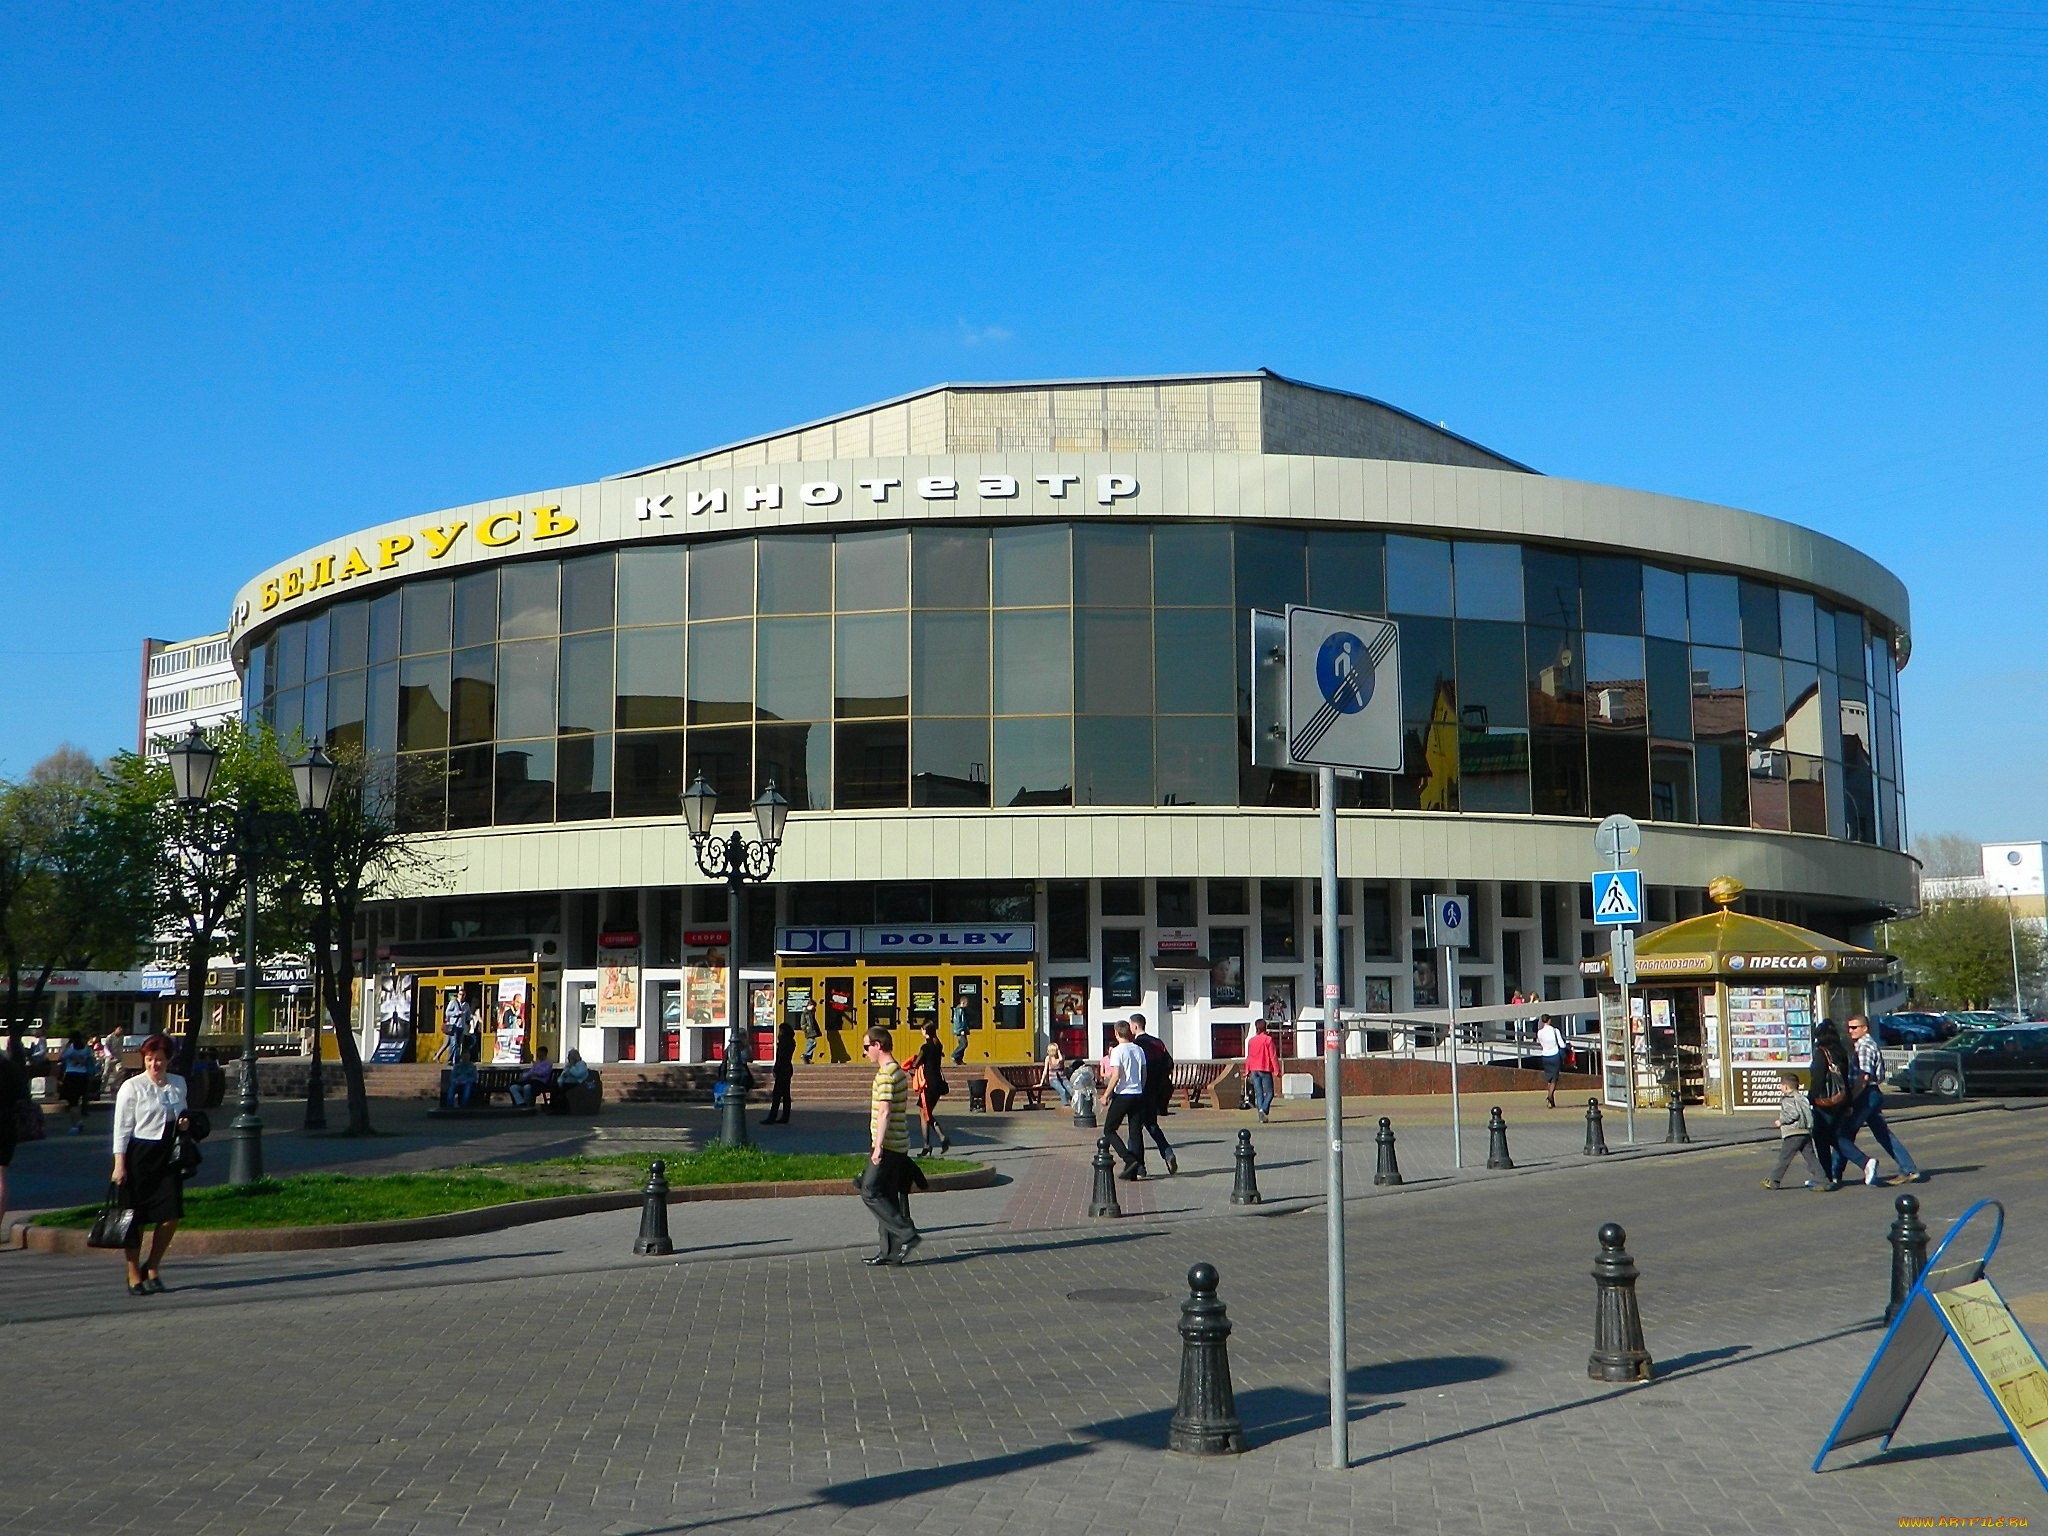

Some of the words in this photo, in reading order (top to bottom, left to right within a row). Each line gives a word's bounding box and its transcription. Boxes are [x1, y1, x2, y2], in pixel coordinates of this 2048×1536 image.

[260, 504, 579, 612] БЕЛАРУСЬ
[605, 935, 634, 943] СЕГОДНЯ
[880, 932, 1014, 946] DOLBY
[1749, 956, 1807, 969] ПРЕССА
